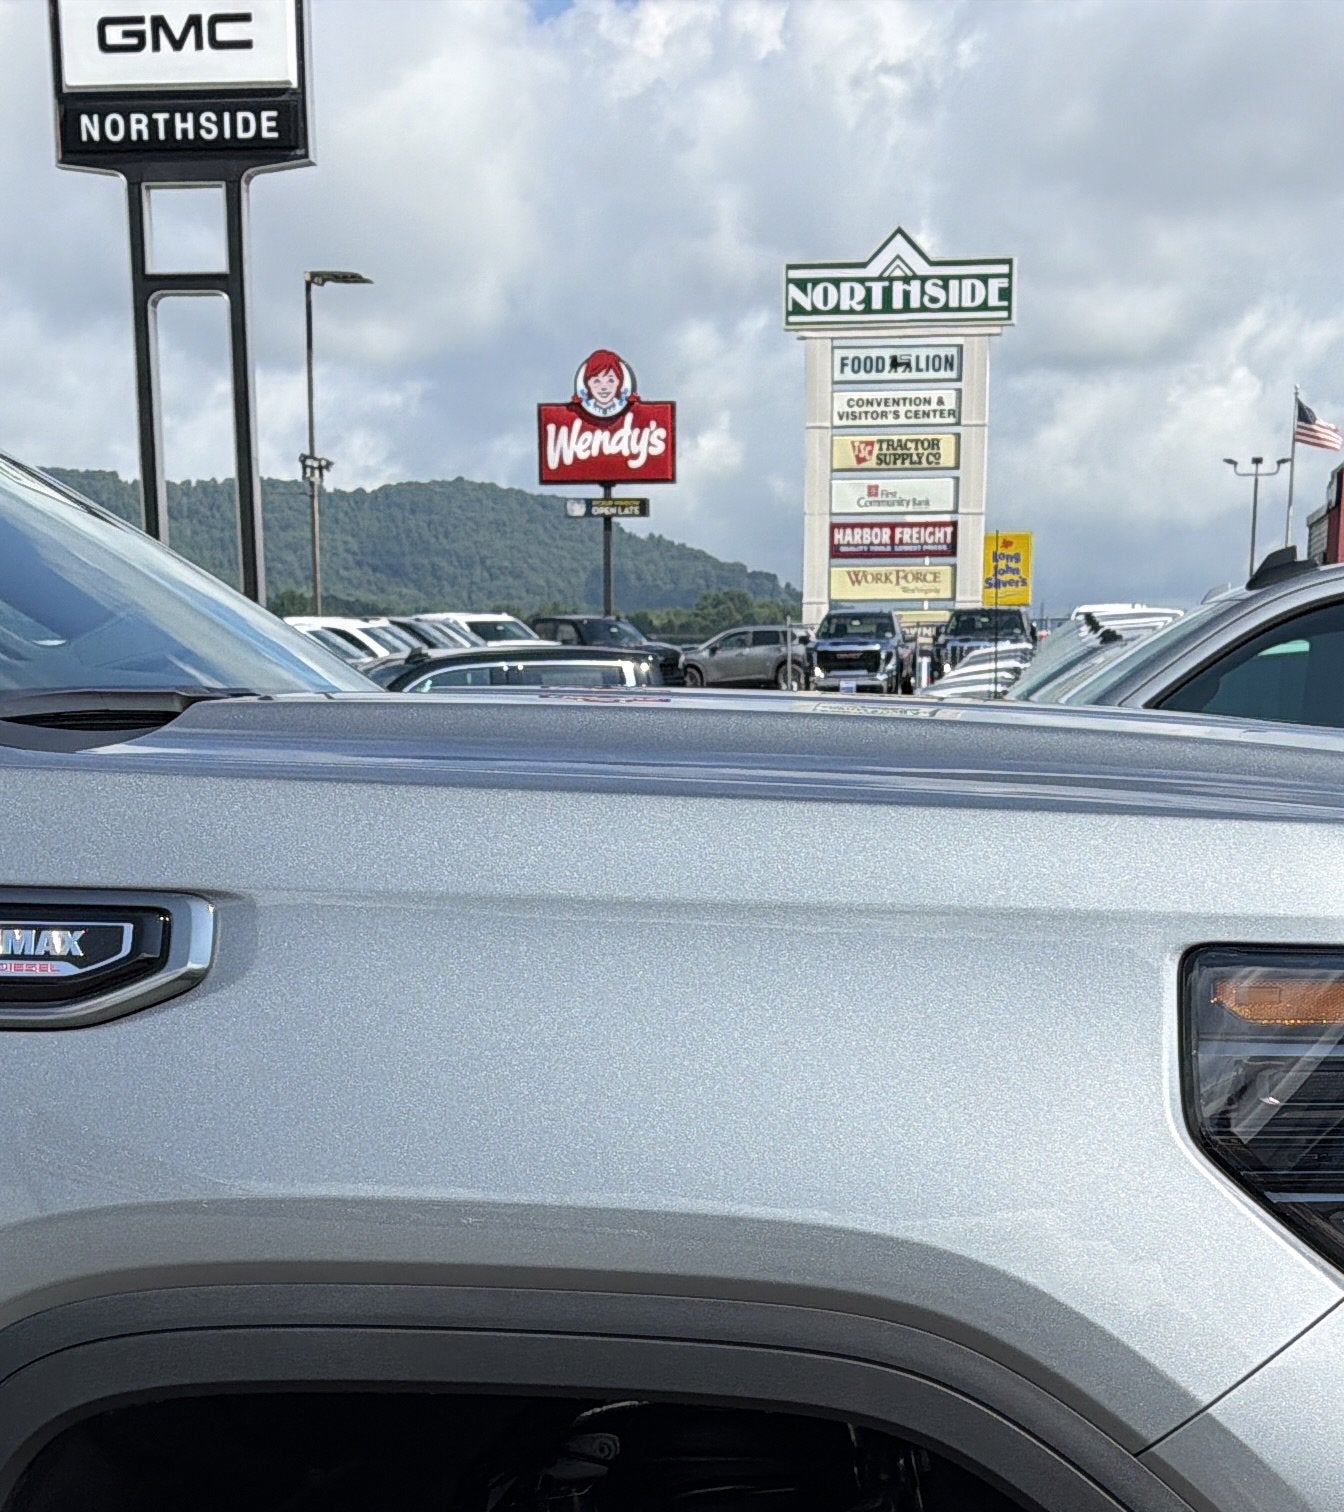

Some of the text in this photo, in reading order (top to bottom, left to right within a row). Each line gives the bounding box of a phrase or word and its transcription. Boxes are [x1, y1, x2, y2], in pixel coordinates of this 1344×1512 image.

[97, 12, 253, 53] GMC
[80, 110, 280, 142] NORTHSIDE
[787, 279, 1009, 312] NORTHSIDE
[839, 353, 956, 375] FOOD LION
[846, 395, 946, 409] CONVENTION &
[837, 408, 957, 422] VISITOR'S CENTER
[546, 411, 667, 470] Wendy's
[876, 438, 941, 452] TRACTOR
[876, 452, 924, 466] SUPPLY
[833, 526, 954, 545] HARBOR FREIGHT
